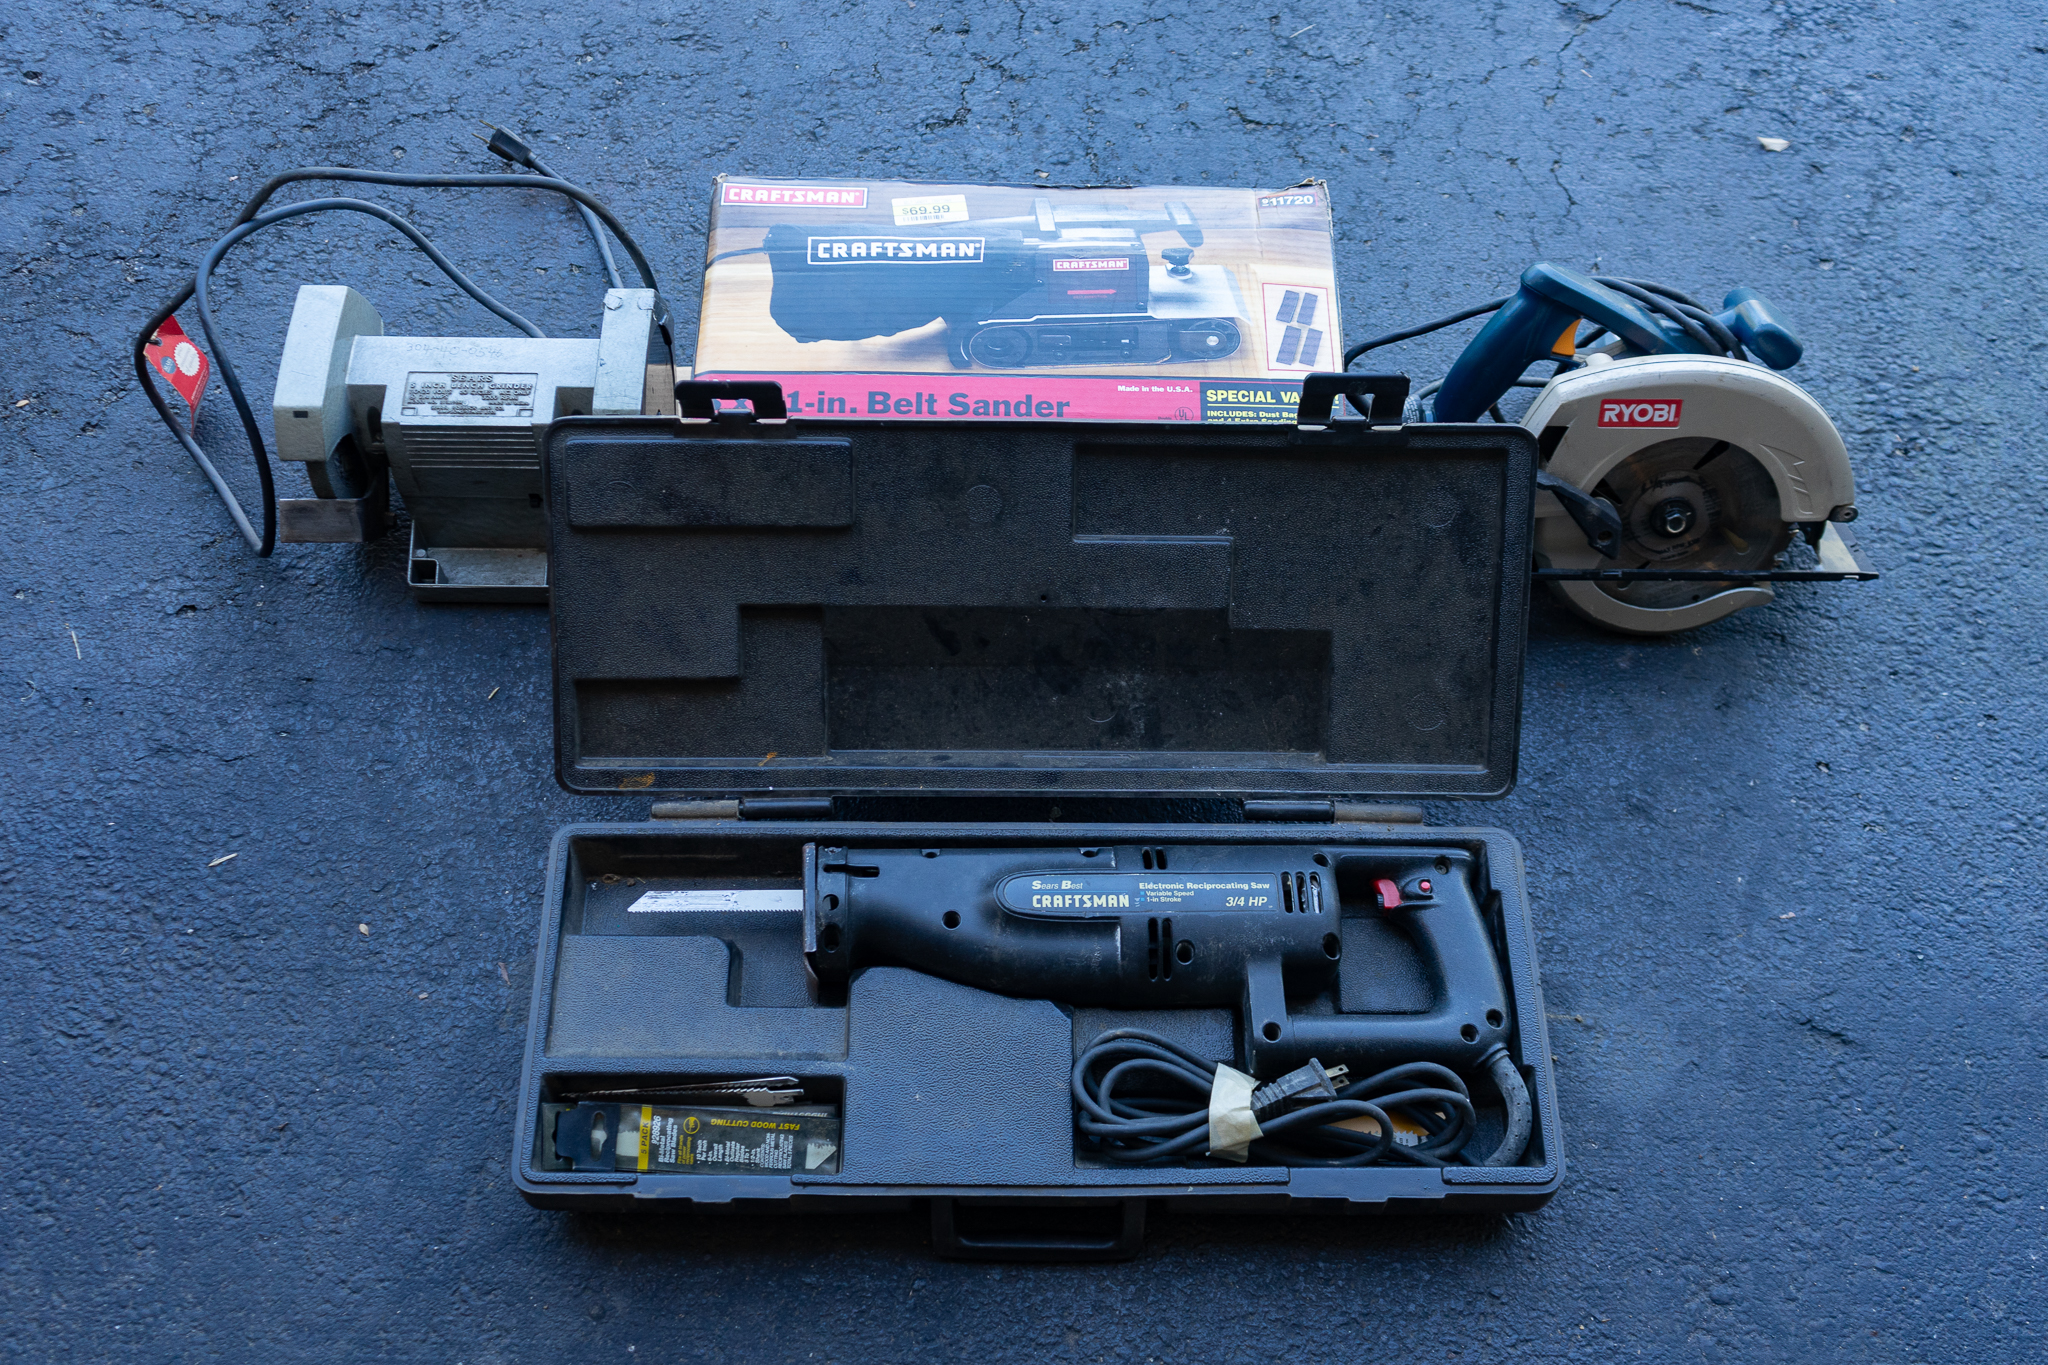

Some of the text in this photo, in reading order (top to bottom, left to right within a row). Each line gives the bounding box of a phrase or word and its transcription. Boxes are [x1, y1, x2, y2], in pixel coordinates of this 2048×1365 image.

[728, 188, 855, 203] CRAFTSMAN
[902, 204, 950, 216] $69.99
[818, 242, 975, 258] CRAFTSMAN
[1056, 260, 1124, 268] CRAFTSMAN
[451, 374, 493, 382] SEARS
[1206, 390, 1276, 402] SPECIAL
[786, 390, 858, 414] 1-in.
[868, 391, 937, 416] Belt
[948, 392, 1070, 417] Sander
[1603, 404, 1676, 422] RYOBI
[1032, 880, 1083, 890] Sears Best
[1186, 882, 1248, 890] Reciprocating
[1032, 894, 1130, 908] CRAFTSMAN
[1226, 896, 1268, 907] 3/4 HP
[710, 1118, 749, 1127] CUTTING
[664, 1118, 674, 1163] Reciprocating
